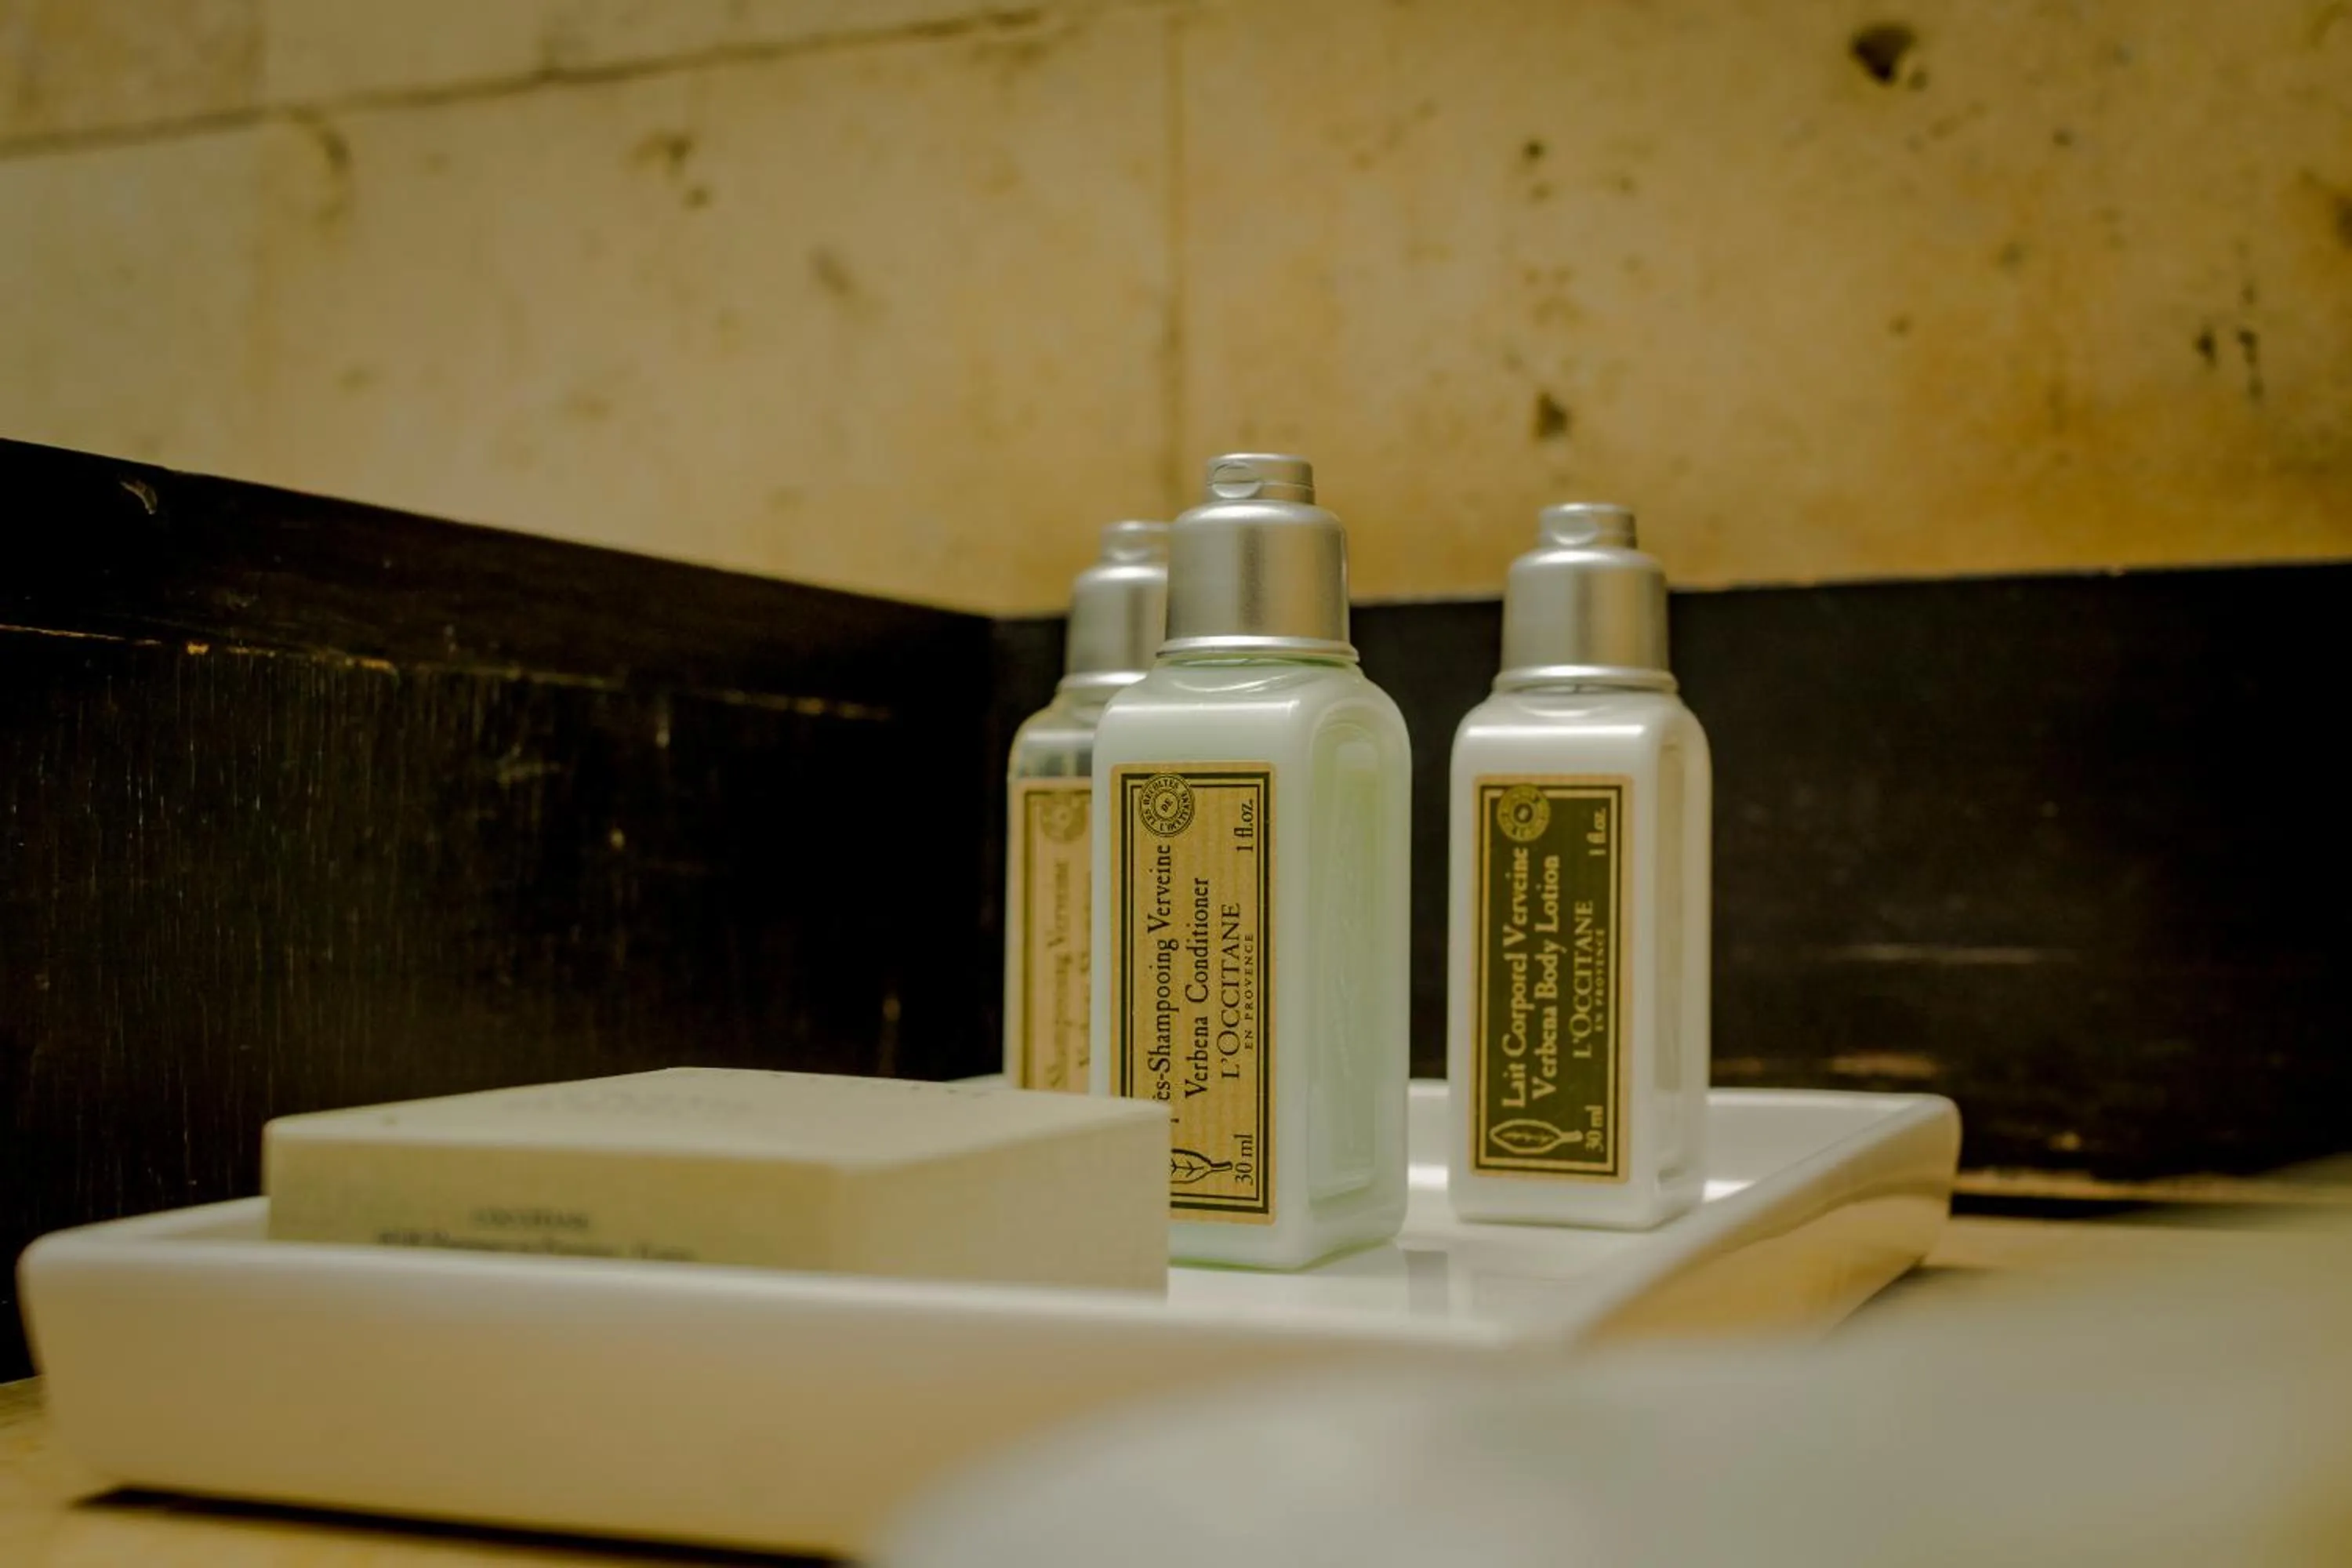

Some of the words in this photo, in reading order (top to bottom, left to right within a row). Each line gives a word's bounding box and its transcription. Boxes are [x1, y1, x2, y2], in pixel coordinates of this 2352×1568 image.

[1147, 844, 1171, 934] Verveine
[1502, 848, 1529, 948] Verveine
[1534, 855, 1559, 932] Lotion
[1185, 877, 1209, 1003] Conditioner
[1244, 934, 1254, 1021] PROVENCE
[1534, 939, 1567, 999] Body
[1570, 900, 1593, 1058] L'OCCITANE
[1147, 938, 1179, 1123] ès-Shampooing
[1216, 902, 1240, 1079] L'OCCITANE
[1501, 953, 1535, 1057] Corporel
[1185, 1016, 1208, 1098] Verbena
[1244, 1029, 1254, 1050] EN
[1532, 1006, 1558, 1100] Verbena
[1501, 1062, 1526, 1108] Lait
[1584, 1105, 1604, 1128] ml
[1233, 1134, 1253, 1157] ml
[1234, 1163, 1254, 1185] 30
[1584, 1130, 1604, 1152] 30
